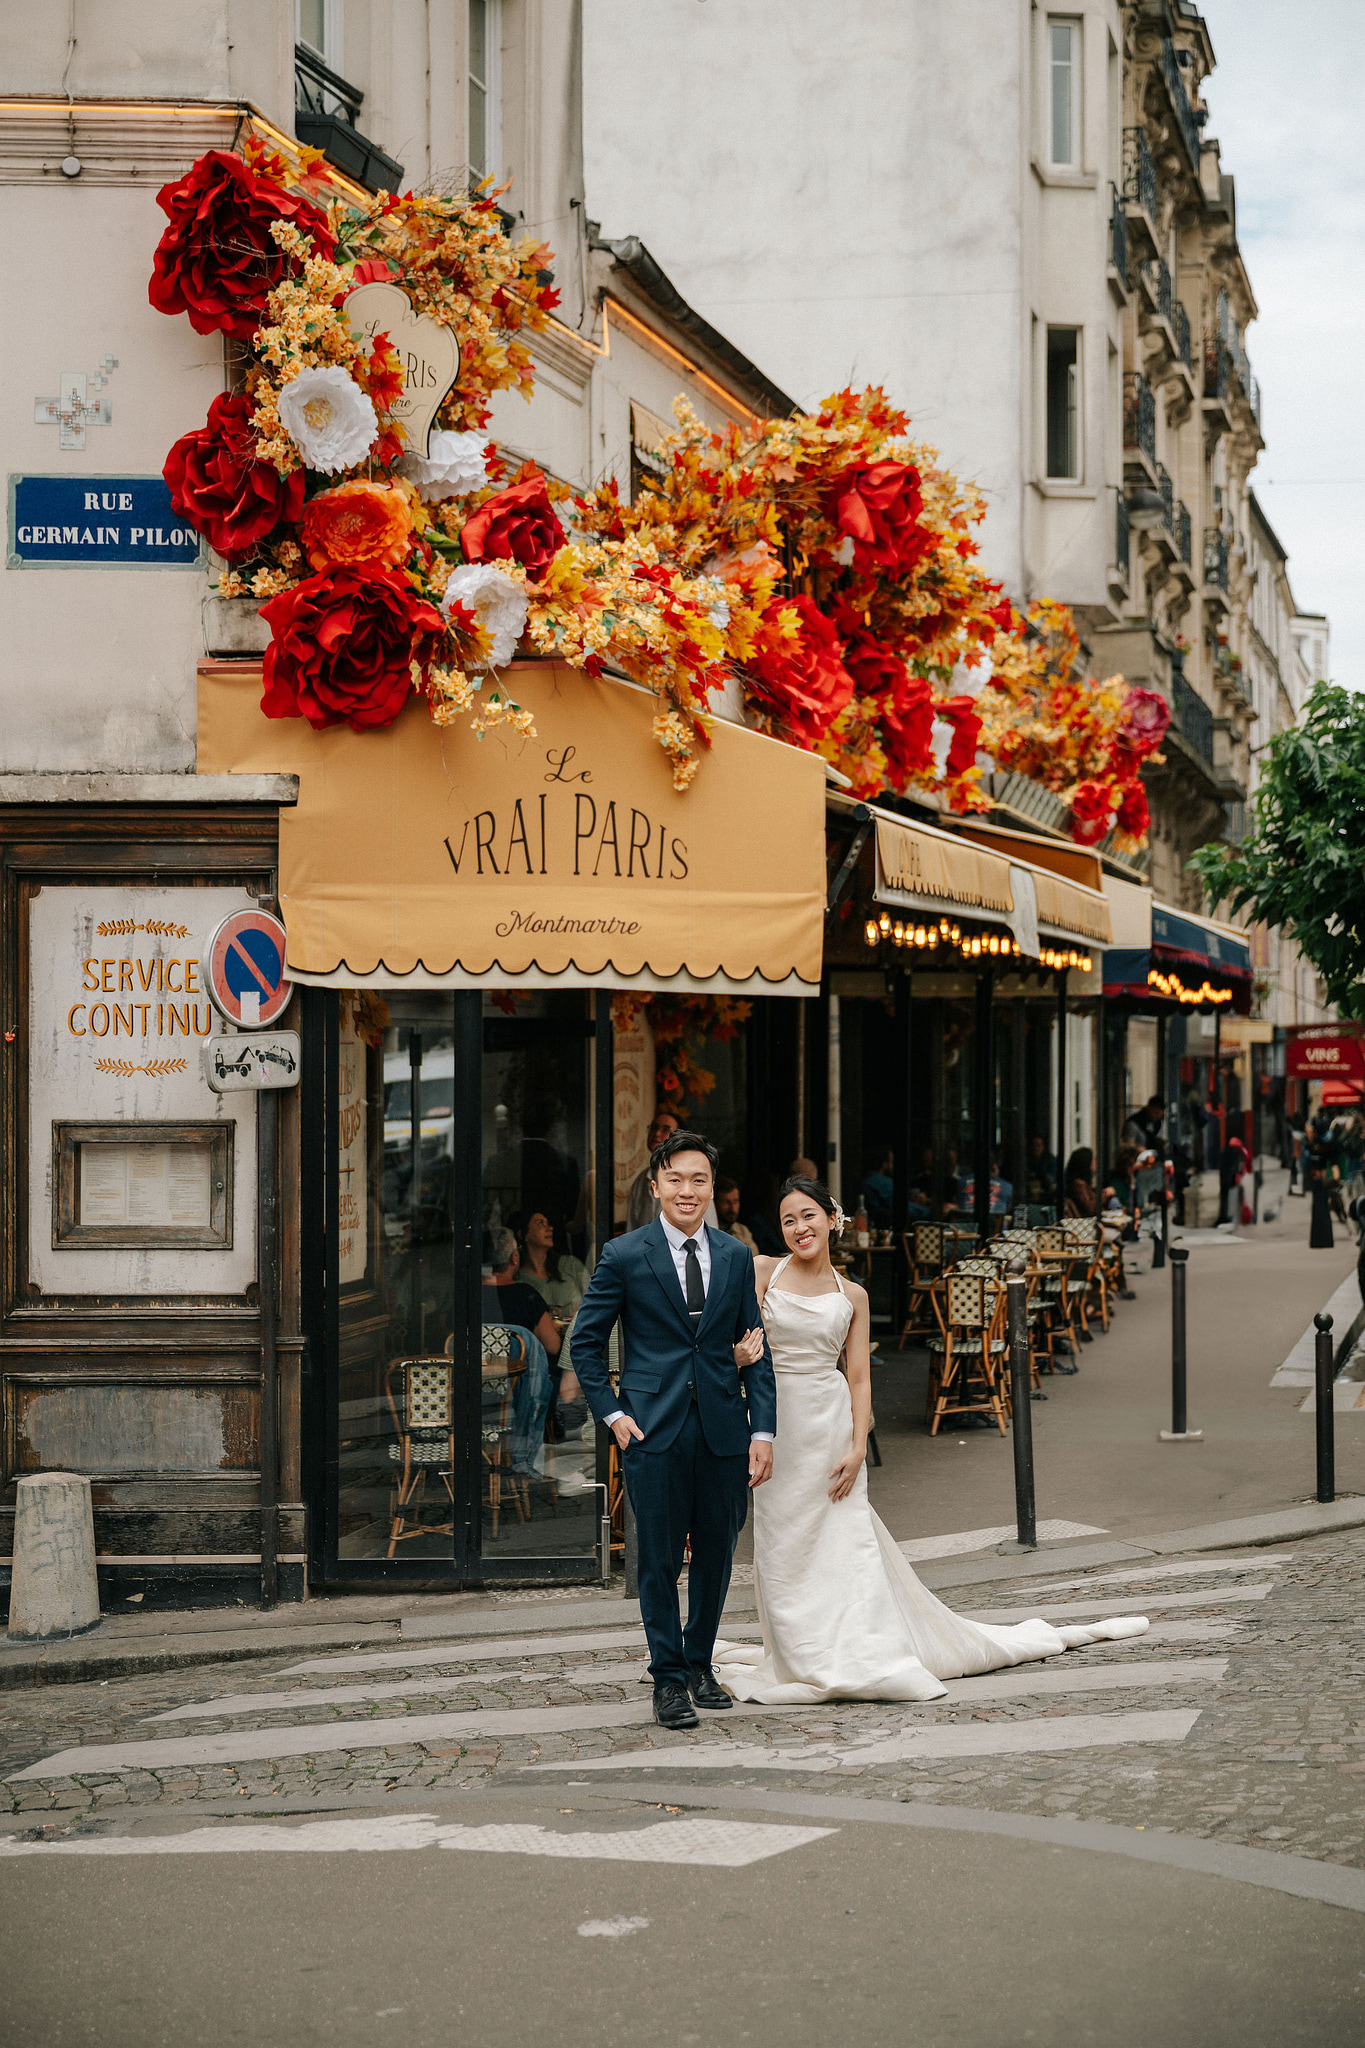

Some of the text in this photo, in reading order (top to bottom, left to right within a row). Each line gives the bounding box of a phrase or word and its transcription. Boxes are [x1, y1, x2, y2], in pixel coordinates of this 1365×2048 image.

[84, 492, 133, 511] RUE
[17, 526, 198, 546] GERMAIN PILON
[543, 746, 594, 783] Le
[443, 793, 688, 879] VRAI PARIS
[495, 910, 642, 937] Montmartre
[82, 958, 200, 993] SERVICE
[67, 1003, 212, 1037] CONTINU
[1305, 1047, 1340, 1063] VINS
